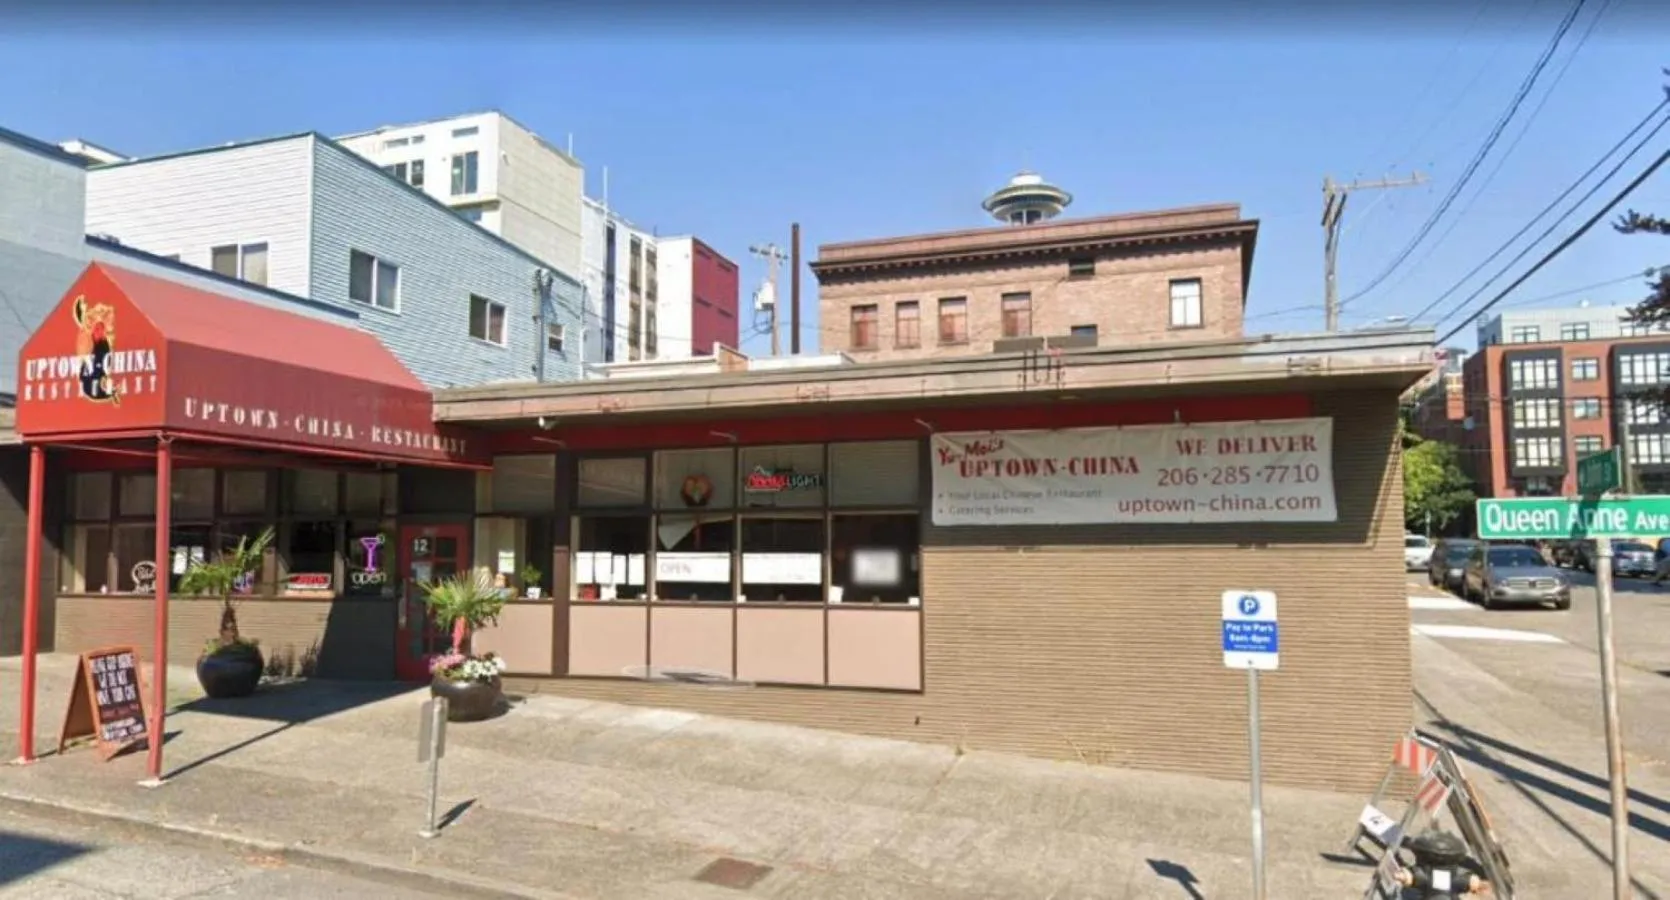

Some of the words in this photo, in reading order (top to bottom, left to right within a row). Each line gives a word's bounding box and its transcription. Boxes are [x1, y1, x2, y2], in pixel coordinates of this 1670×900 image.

[184, 397, 278, 429] UPTOWN
[294, 414, 355, 440] CHINA
[371, 425, 466, 457] RESTAURANT
[1176, 438, 1207, 456] WE
[1218, 435, 1318, 455] DELIVER
[1117, 495, 1322, 516] uptown-china.com
[1485, 503, 1560, 532] Queen
[1566, 503, 1629, 532] Anne
[1634, 512, 1670, 531] Ave
[413, 538, 429, 553] 12
[351, 571, 387, 585] open
